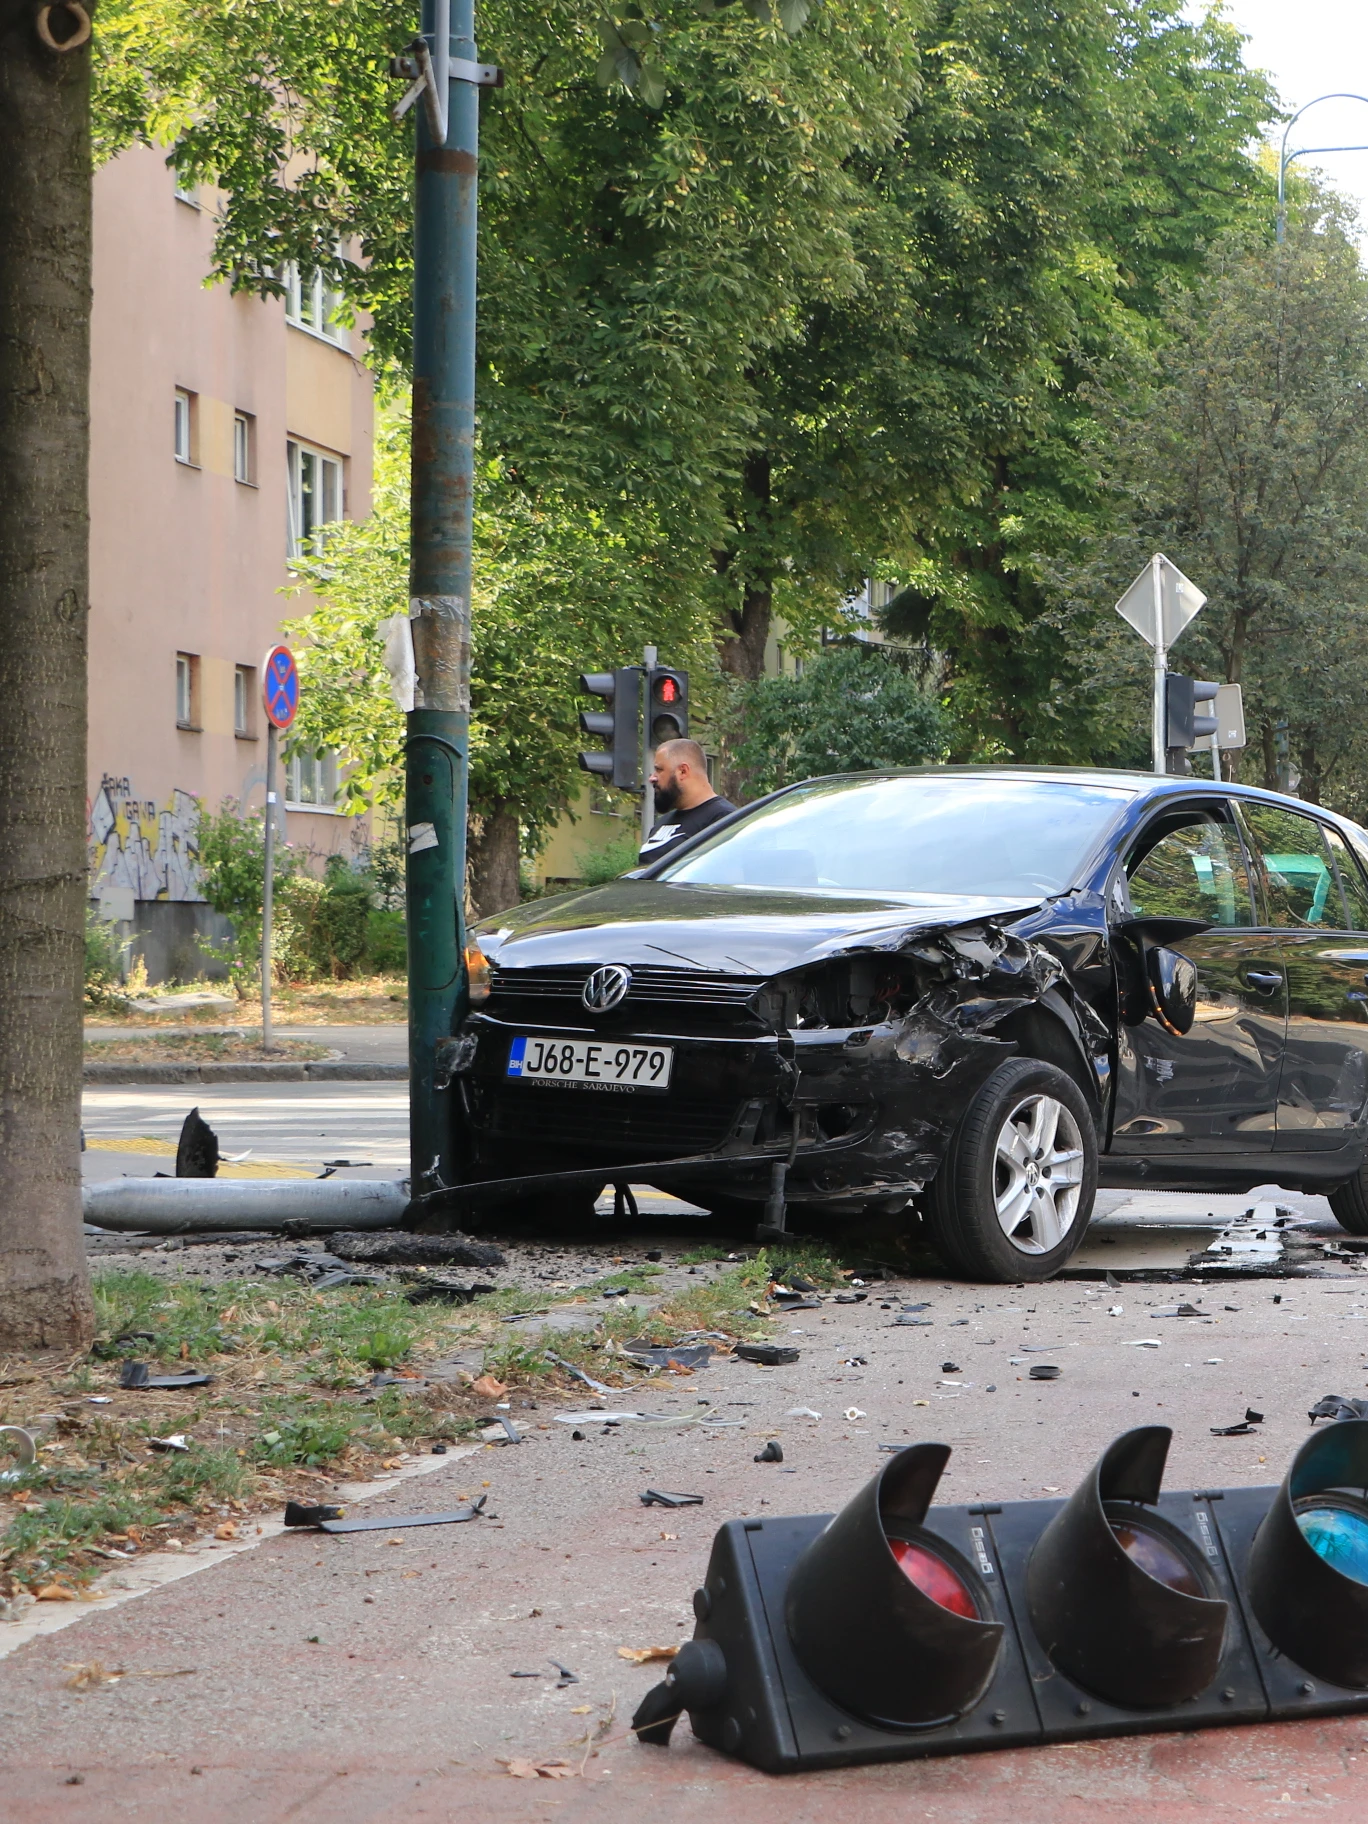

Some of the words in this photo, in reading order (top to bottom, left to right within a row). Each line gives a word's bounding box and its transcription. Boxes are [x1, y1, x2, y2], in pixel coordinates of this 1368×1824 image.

[509, 1059, 523, 1069] BIH
[527, 1042, 666, 1081] J68-E-979
[531, 1079, 578, 1089] PORSCHE
[582, 1082, 636, 1094] SARAJEVO
